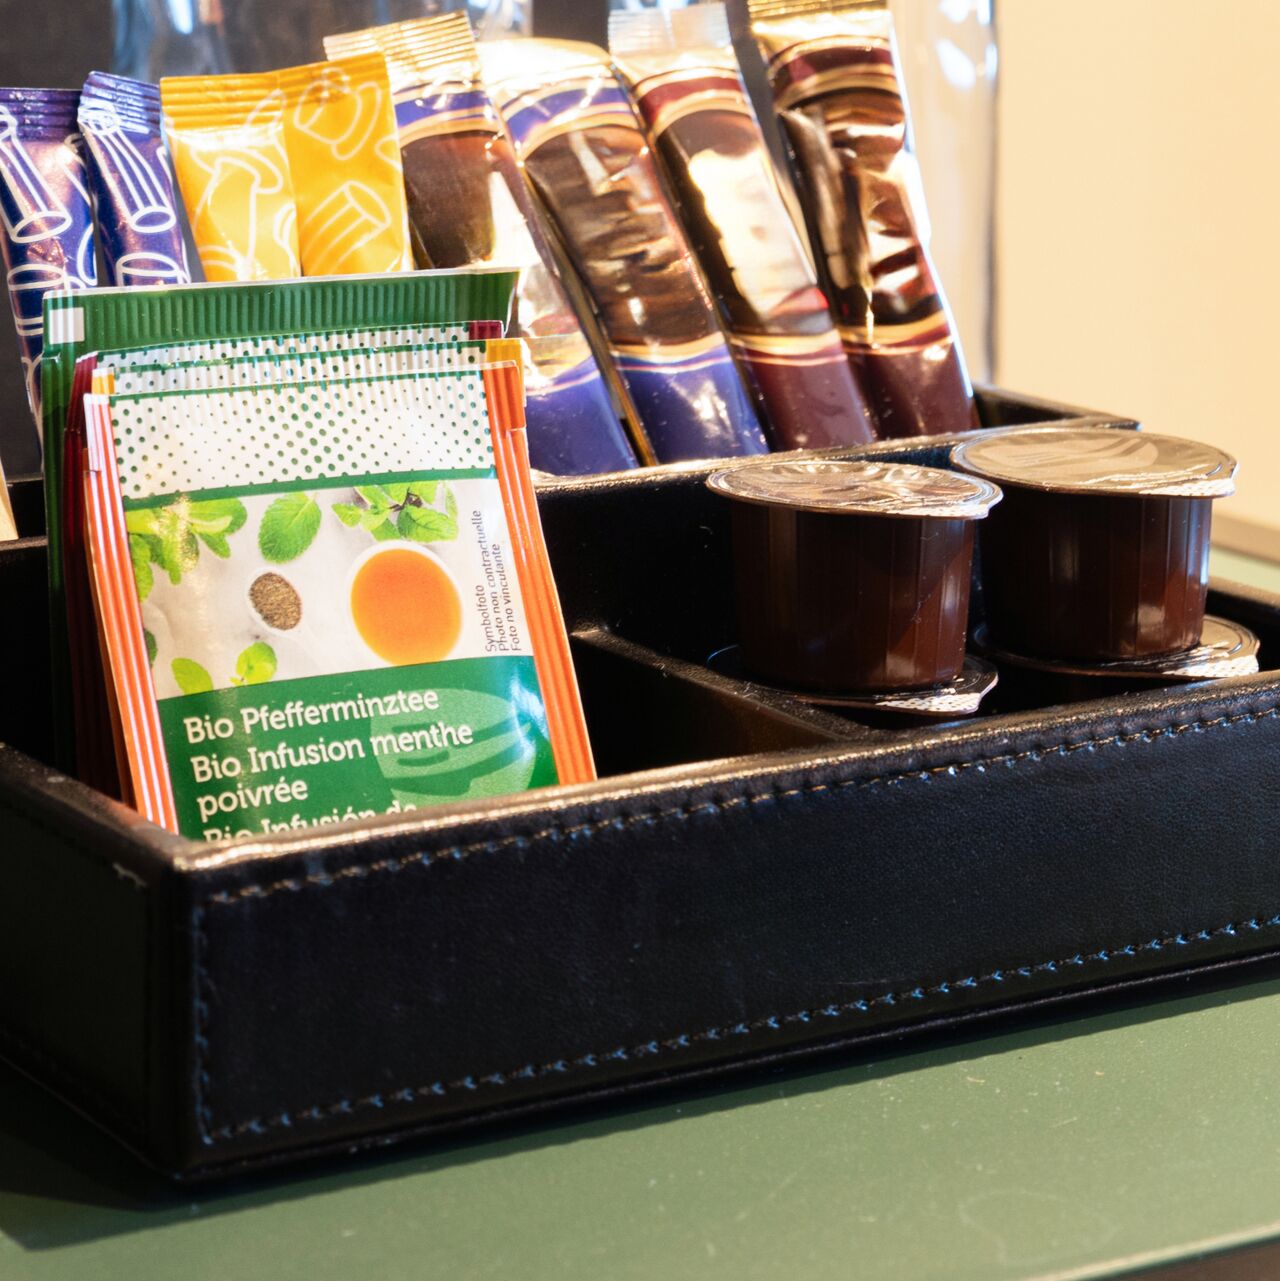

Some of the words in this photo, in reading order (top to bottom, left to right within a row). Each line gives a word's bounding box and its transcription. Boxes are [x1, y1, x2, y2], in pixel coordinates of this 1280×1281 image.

[472, 510, 496, 588] contractuelle
[492, 543, 511, 606] vinculante
[475, 585, 497, 652] Symbolfoto
[490, 592, 502, 614] non
[506, 608, 514, 623] no
[494, 616, 509, 651] Photo
[507, 624, 521, 651] Foto
[183, 714, 234, 744] Bio
[240, 690, 439, 734] Pfefferminztee
[190, 753, 241, 783] Bio
[247, 737, 365, 773] Infusion
[370, 721, 473, 756] menthe
[196, 776, 308, 823] poivrée
